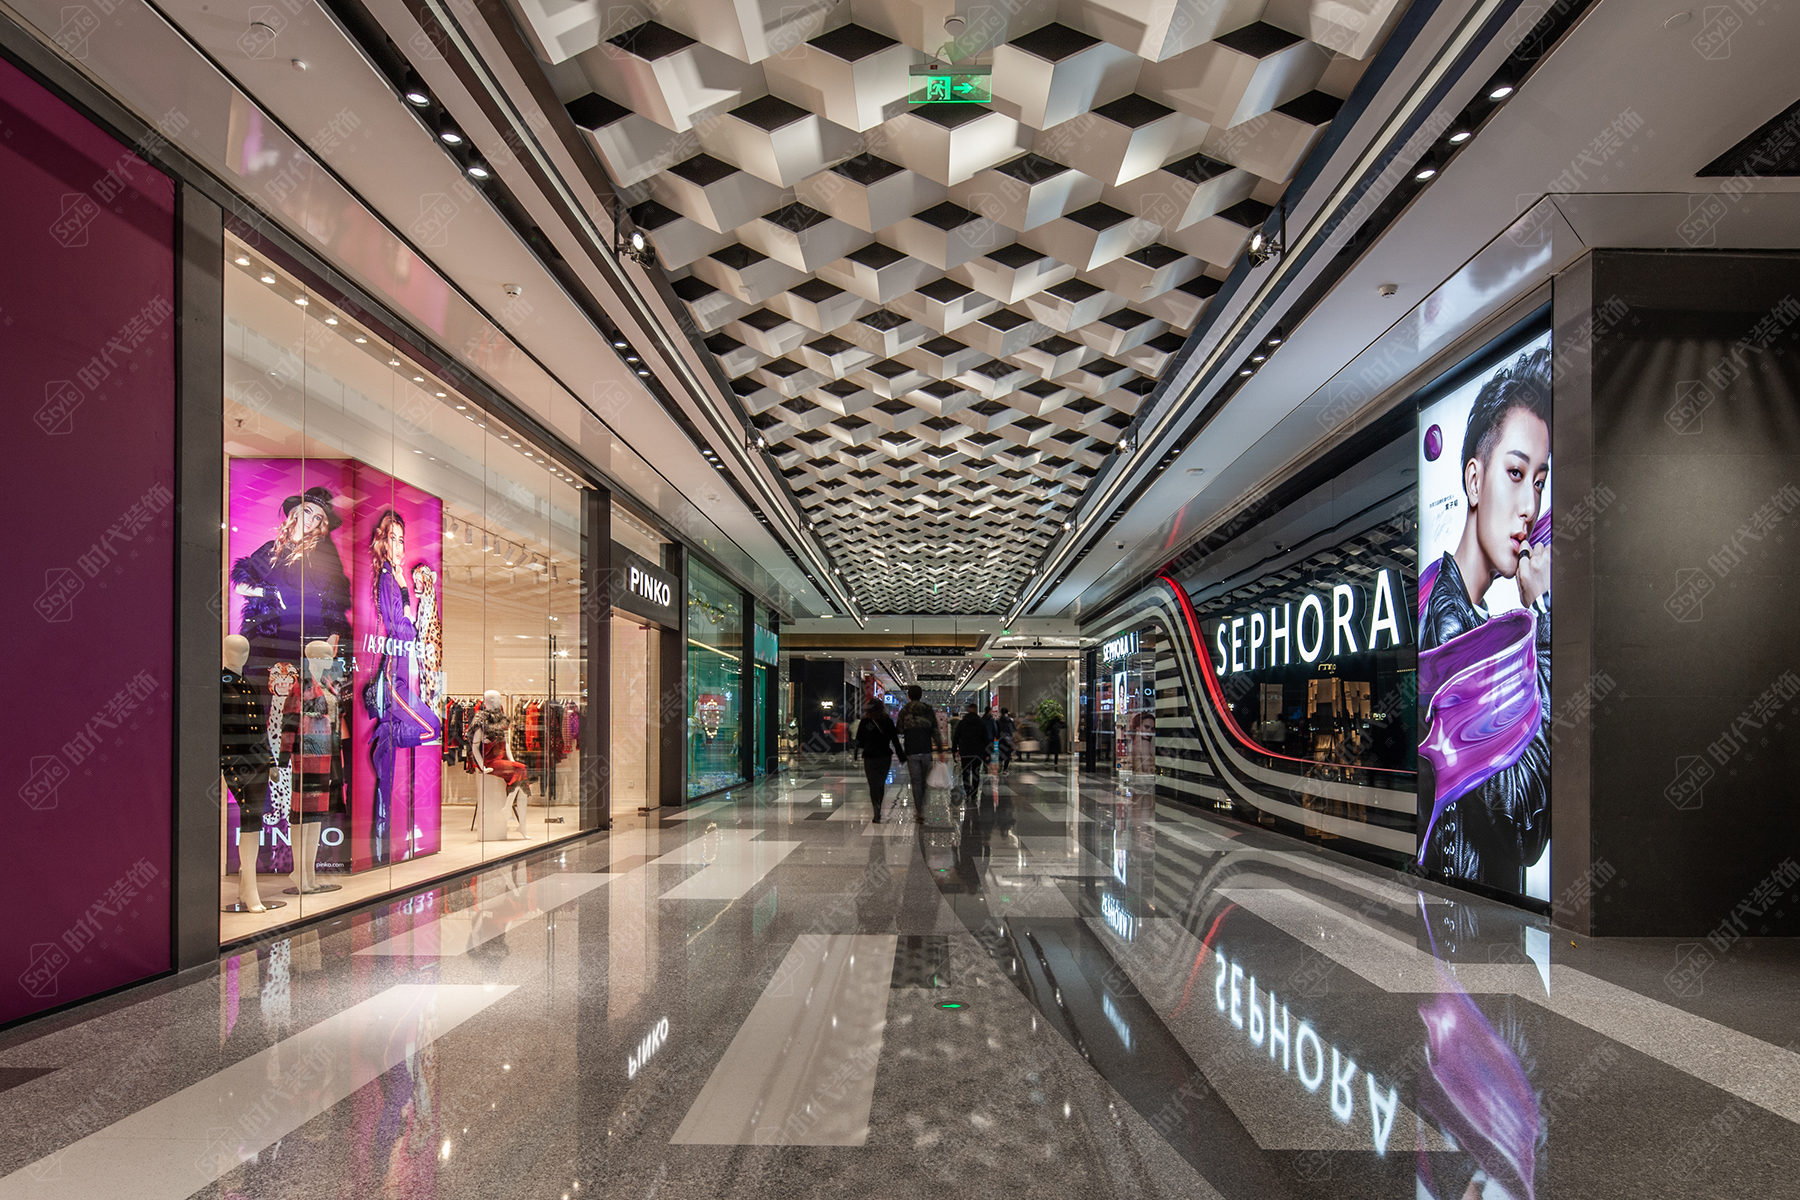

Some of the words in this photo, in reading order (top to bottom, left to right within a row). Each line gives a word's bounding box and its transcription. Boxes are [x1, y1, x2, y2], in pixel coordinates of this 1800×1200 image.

[630, 566, 671, 607] PINKO
[1216, 568, 1401, 676] SEPHORA
[235, 826, 345, 847] INO
